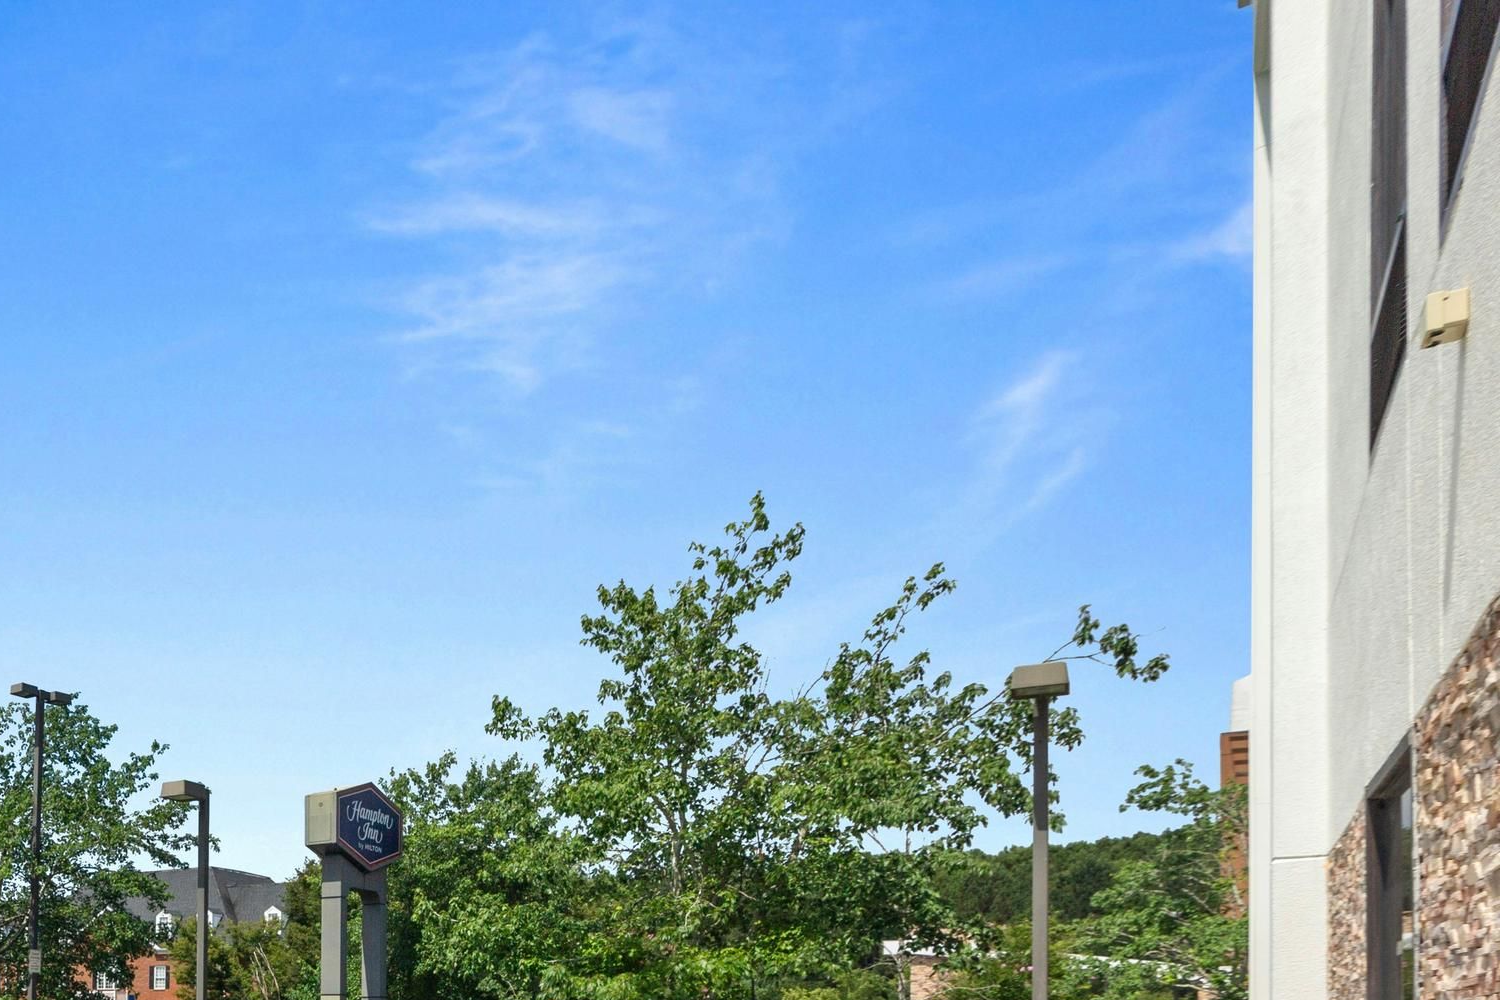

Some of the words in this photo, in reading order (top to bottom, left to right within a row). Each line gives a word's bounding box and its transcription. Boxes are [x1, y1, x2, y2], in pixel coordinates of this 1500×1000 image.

[347, 801, 393, 829] Hampton
[358, 822, 383, 843] Inn
[365, 844, 382, 853] HILTON
